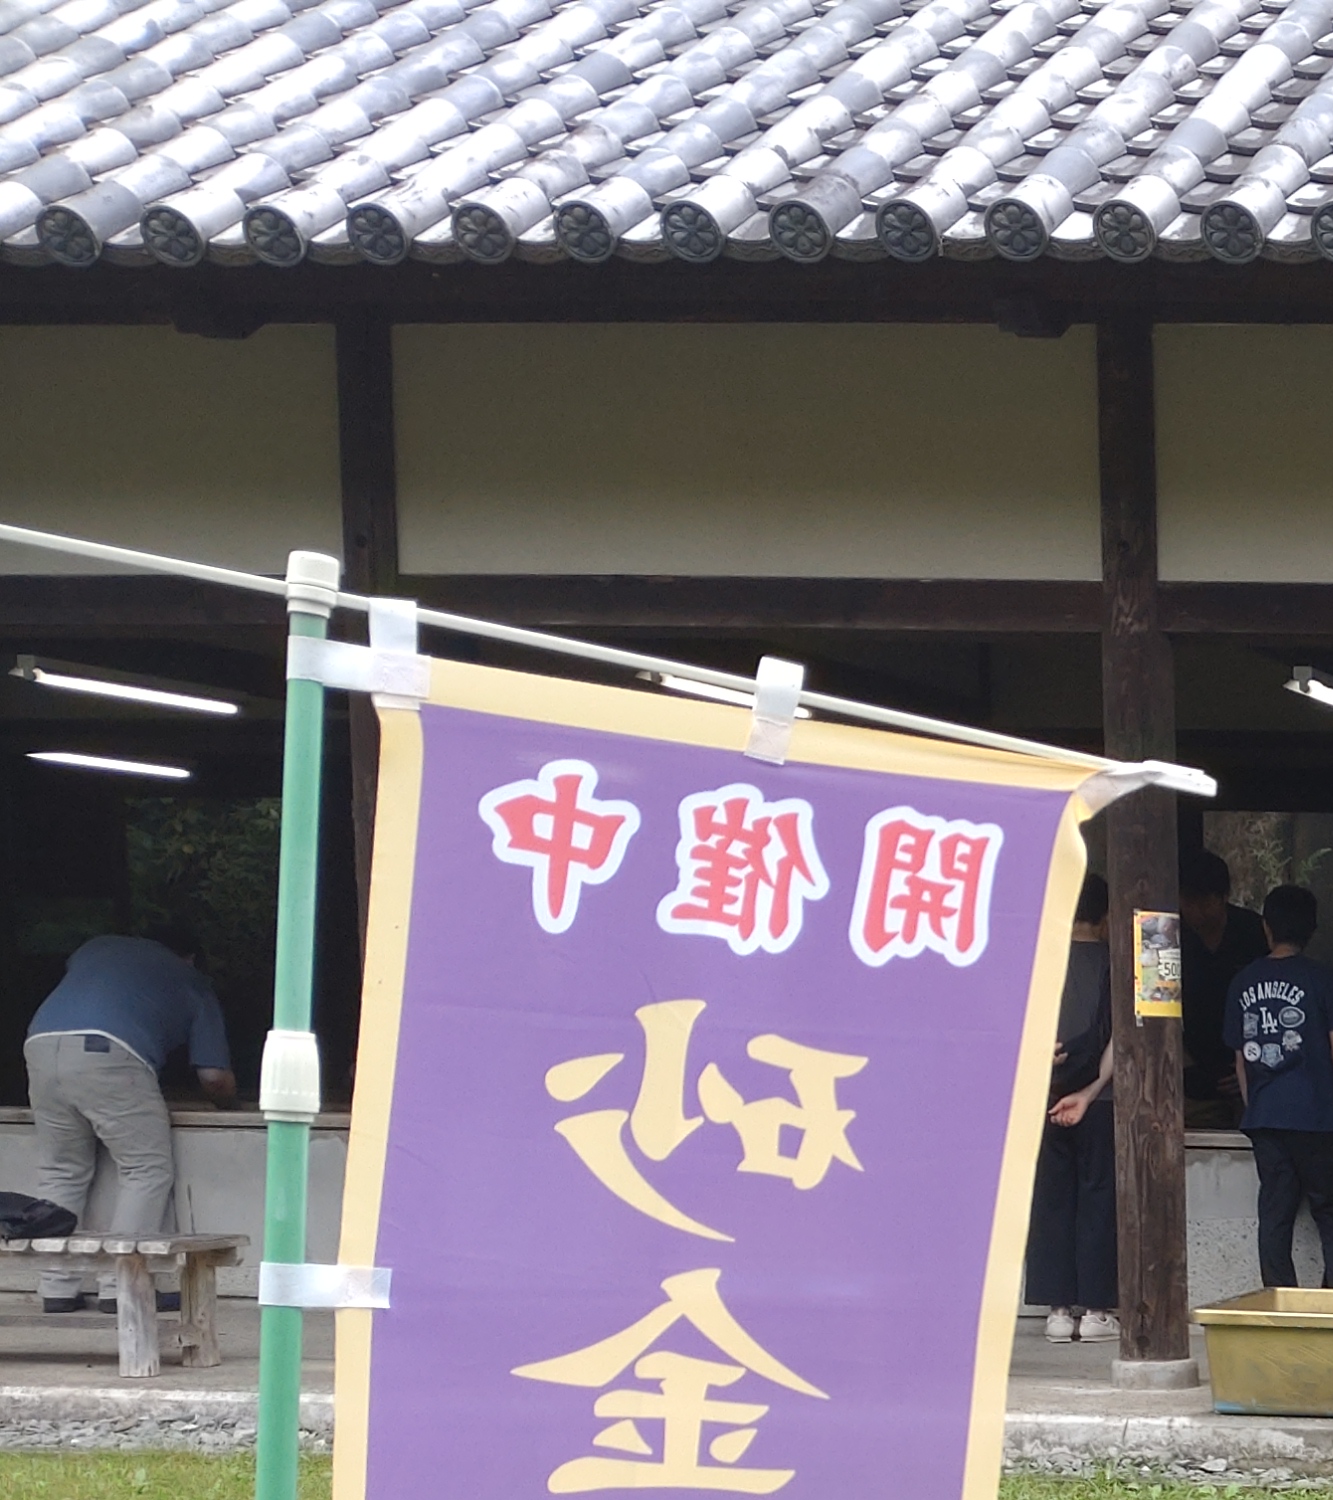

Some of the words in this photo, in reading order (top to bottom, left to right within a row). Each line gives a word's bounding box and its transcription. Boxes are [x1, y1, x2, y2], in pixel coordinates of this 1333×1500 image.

[1239, 986, 1257, 1011] LOS
[1257, 981, 1305, 1006] ANGELES
[1260, 1006, 1279, 1034] LA
